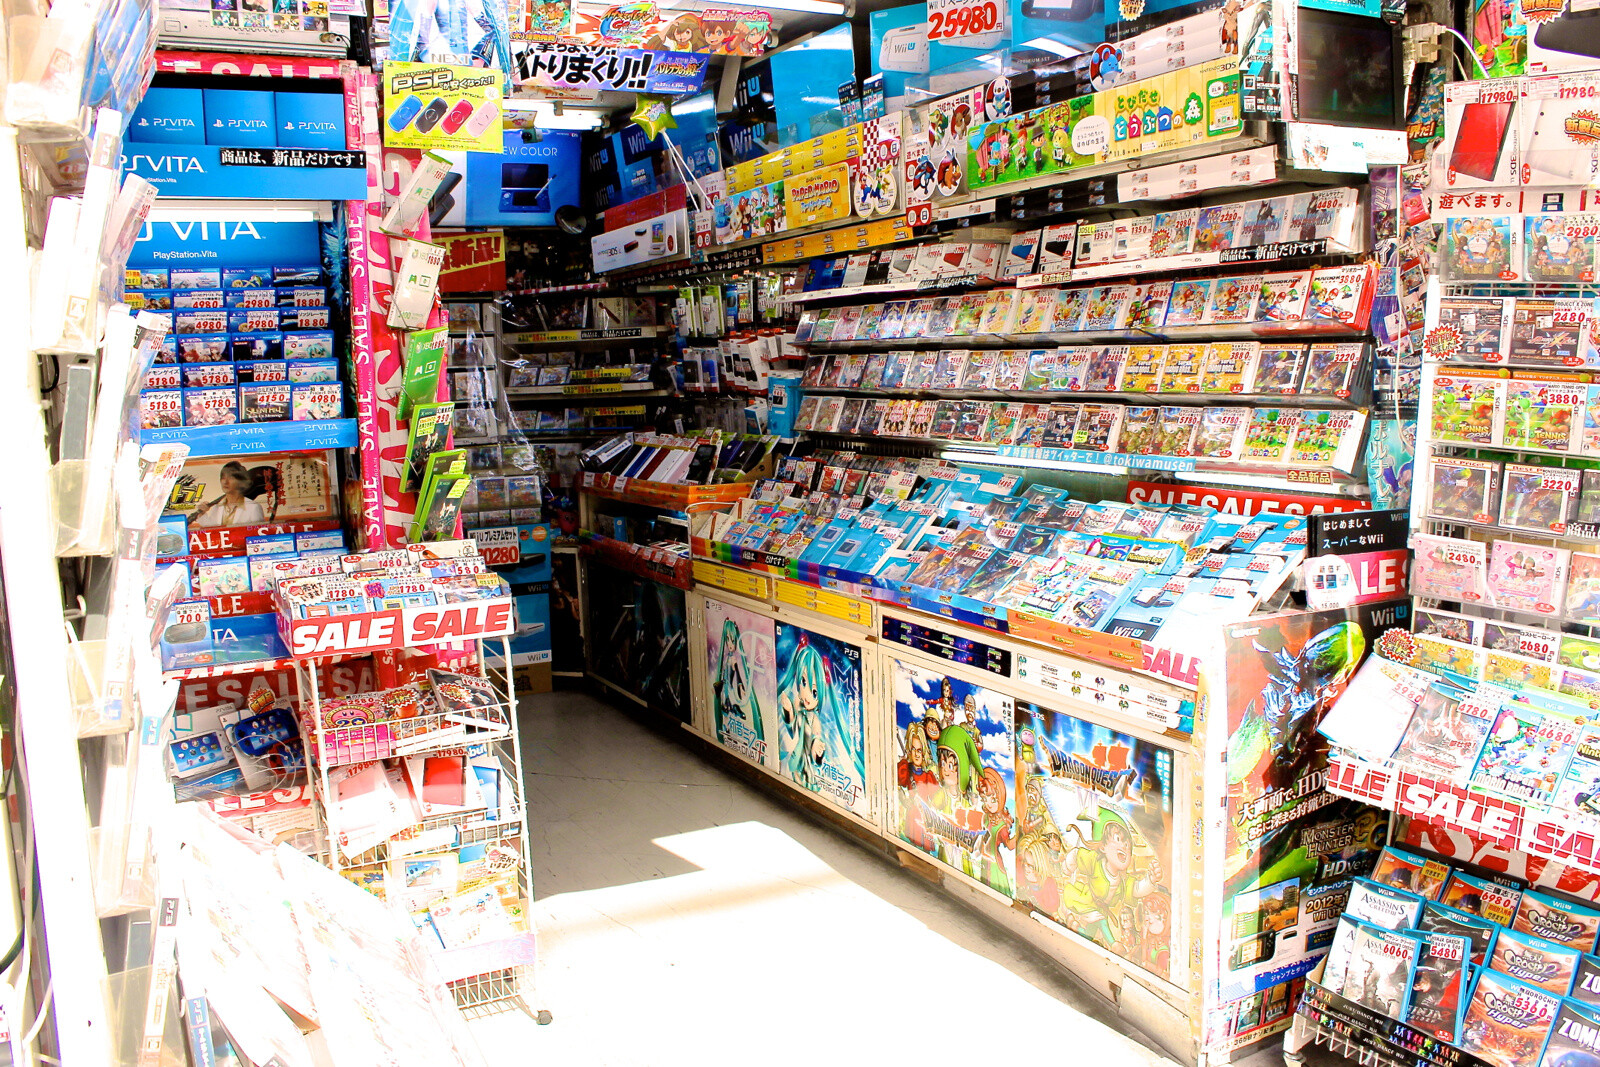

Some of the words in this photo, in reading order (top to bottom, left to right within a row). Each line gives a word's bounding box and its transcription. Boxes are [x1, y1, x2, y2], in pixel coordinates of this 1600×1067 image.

[431, 53, 472, 64] NEXT
[1117, 90, 1159, 109] とびだせ
[520, 146, 558, 157] COLOR
[1438, 194, 1512, 210] 遊べます。
[350, 216, 365, 278] SALE
[354, 304, 370, 364] SALE
[359, 391, 375, 452] SALE
[1103, 454, 1194, 472] @tokiwamusen
[1287, 471, 1332, 484] 全品新品
[364, 476, 381, 537] SALE
[1323, 518, 1371, 531] はじめまして
[189, 531, 233, 551] ALE
[293, 616, 396, 654] SALE
[411, 603, 511, 641] SALE
[1052, 750, 1091, 786] DRAGON
[1401, 785, 1516, 838] SALE
[1301, 822, 1355, 845] MONSTER
[1307, 836, 1352, 860] HUNTER
[1531, 925, 1573, 942] Hyper
[1507, 964, 1549, 983] Hyper
[1486, 1008, 1529, 1028] Hyper
